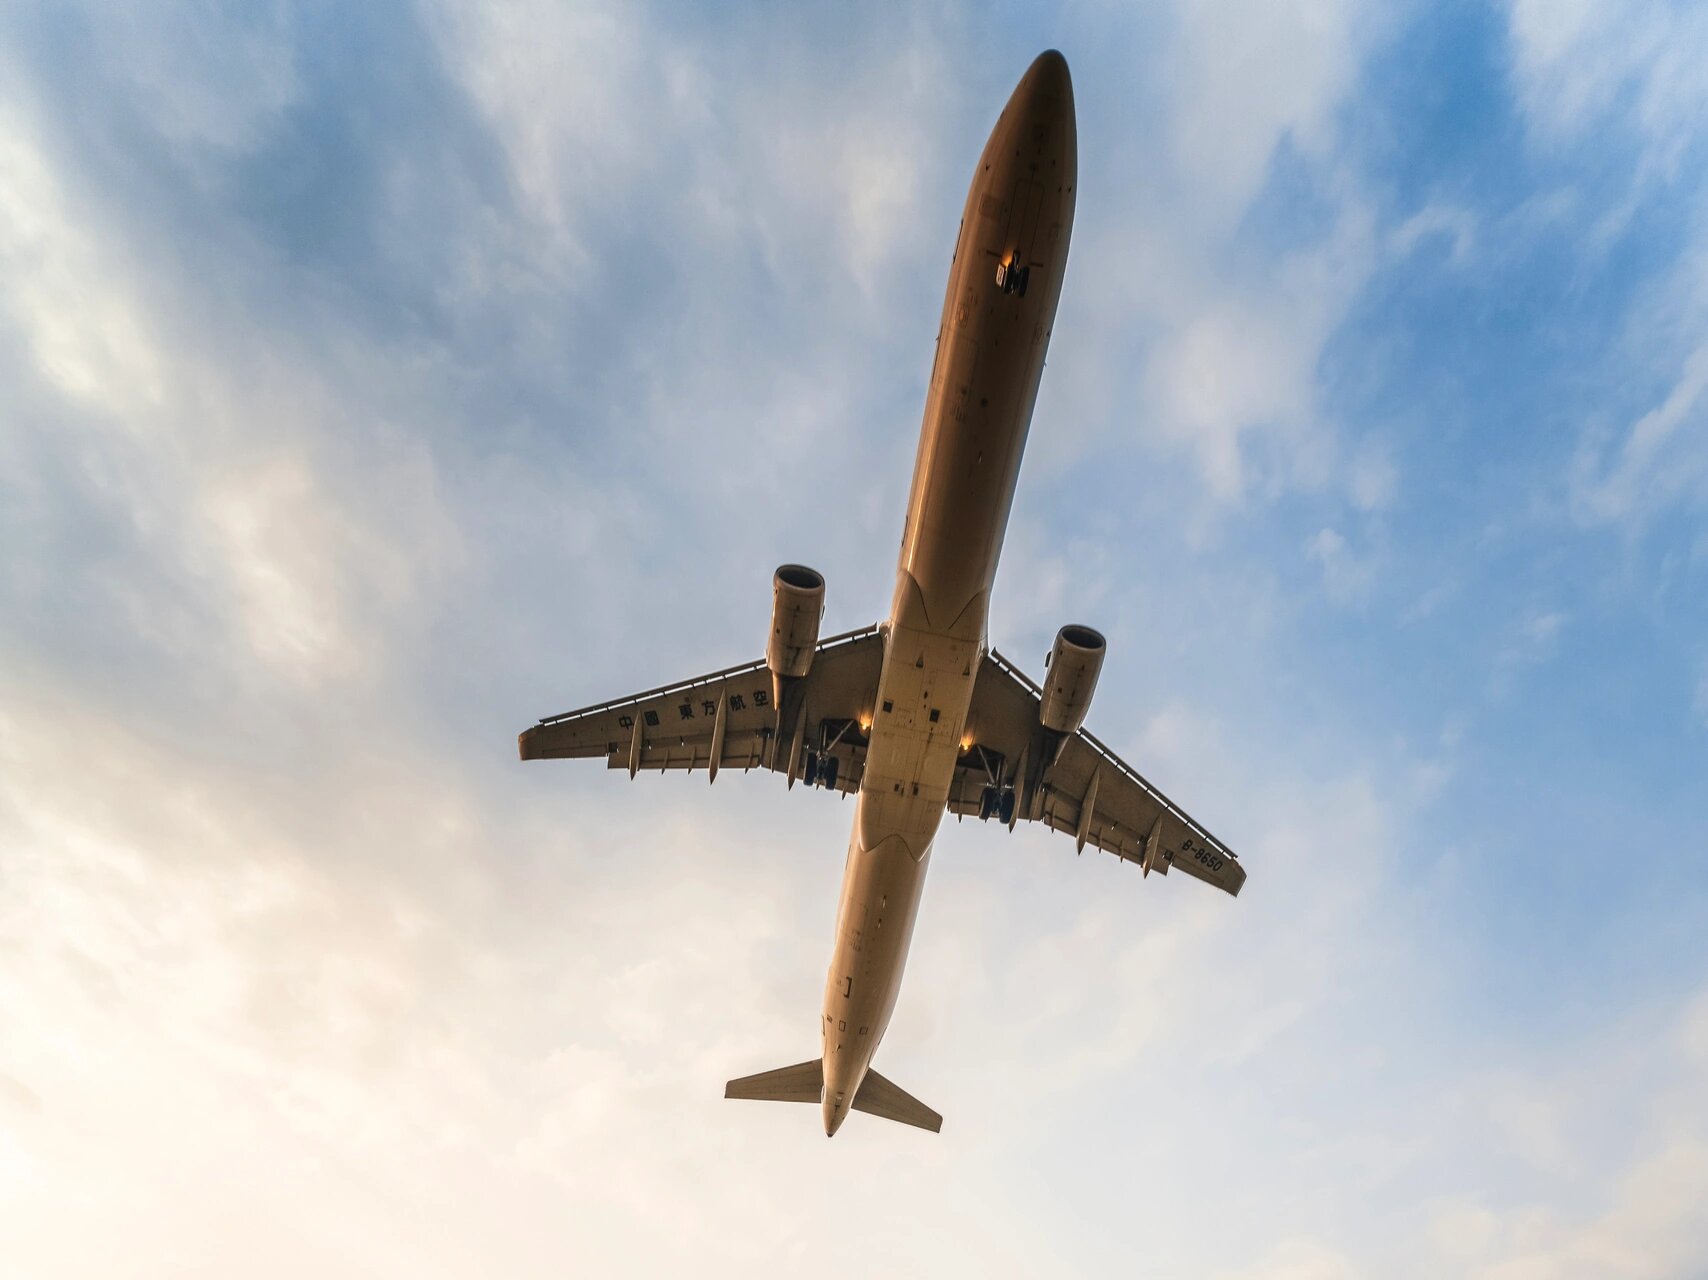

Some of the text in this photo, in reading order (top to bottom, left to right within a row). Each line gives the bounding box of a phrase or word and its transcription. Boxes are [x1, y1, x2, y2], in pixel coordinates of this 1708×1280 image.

[618, 690, 769, 730] 中國東方航空
[1182, 839, 1224, 872] B-8650
